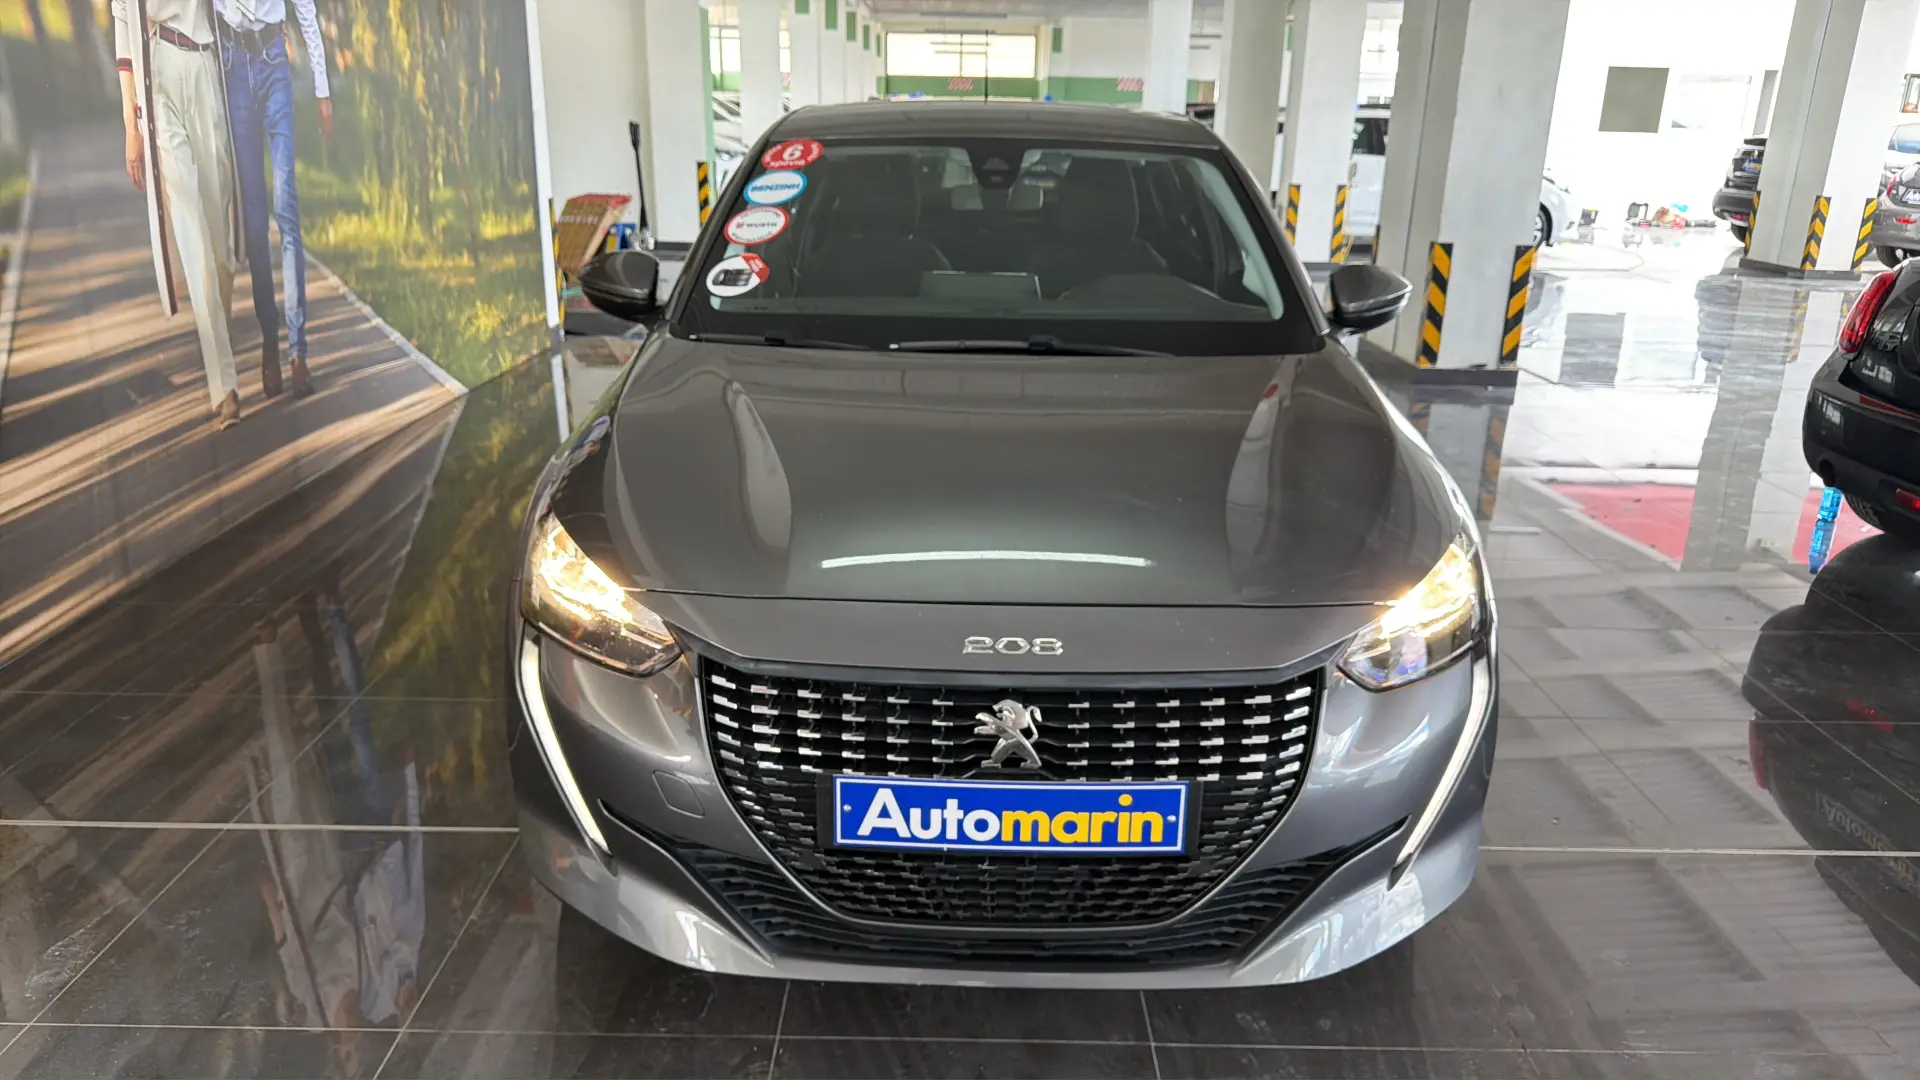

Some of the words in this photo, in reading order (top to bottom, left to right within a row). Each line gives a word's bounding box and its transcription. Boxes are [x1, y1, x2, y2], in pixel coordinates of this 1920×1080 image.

[783, 144, 804, 160] 6
[962, 636, 1064, 655] 208
[856, 788, 1164, 843] Automarin
